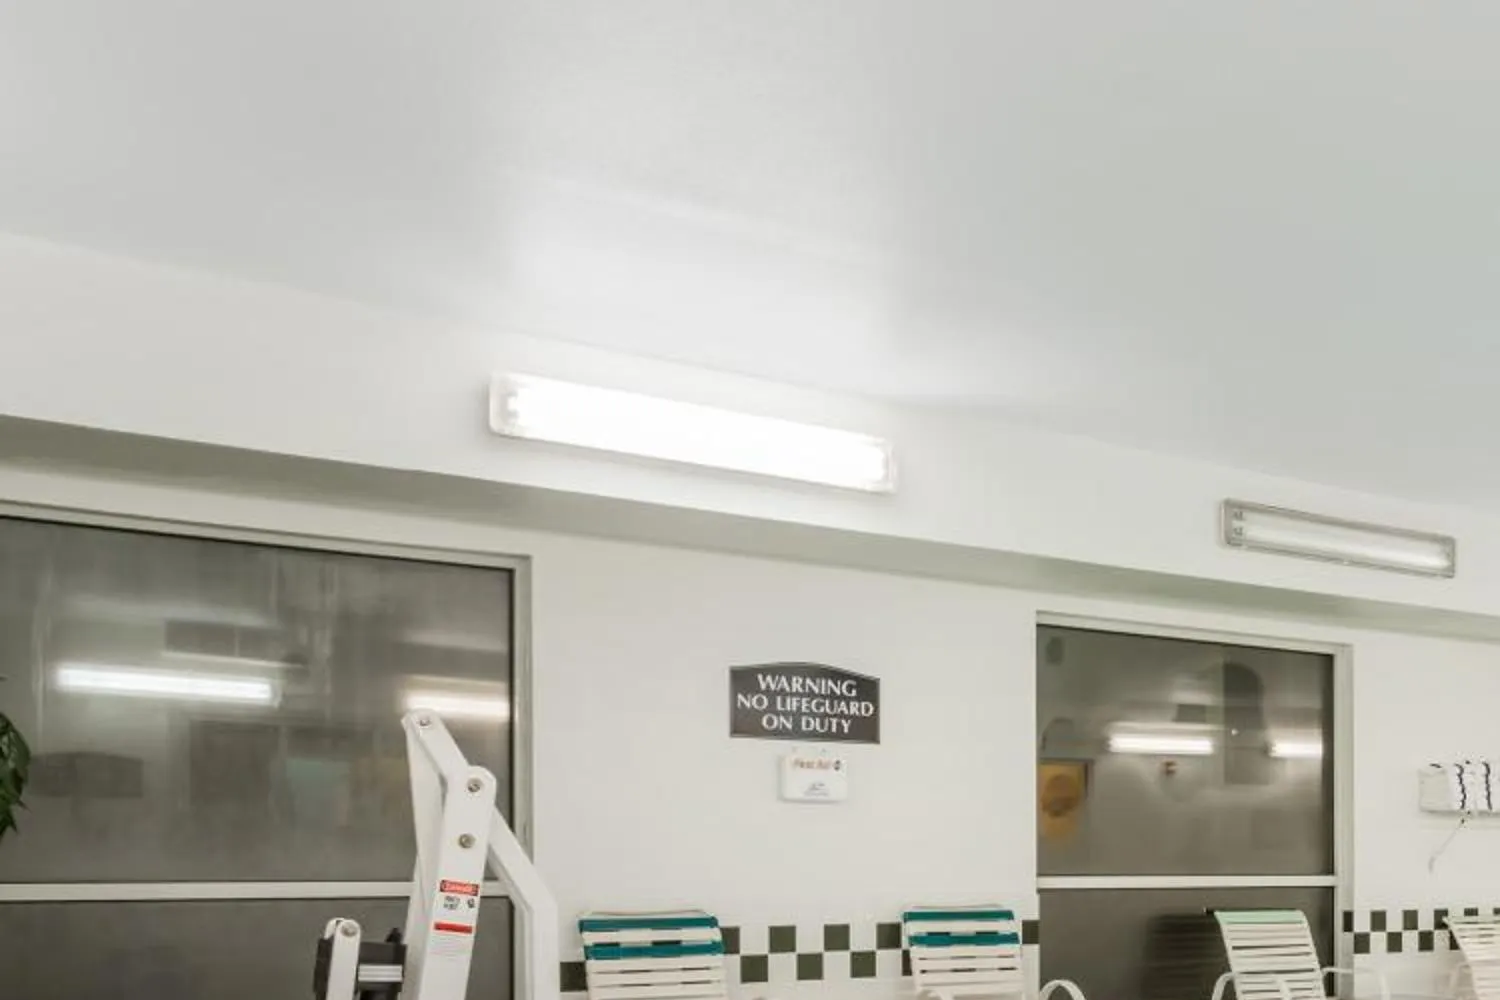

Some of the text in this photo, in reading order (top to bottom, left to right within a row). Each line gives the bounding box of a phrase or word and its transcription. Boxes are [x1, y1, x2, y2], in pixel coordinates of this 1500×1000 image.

[757, 673, 858, 698] WARNING
[737, 693, 874, 718] NO LIFEGUARD
[762, 713, 852, 734] ON DUTY
